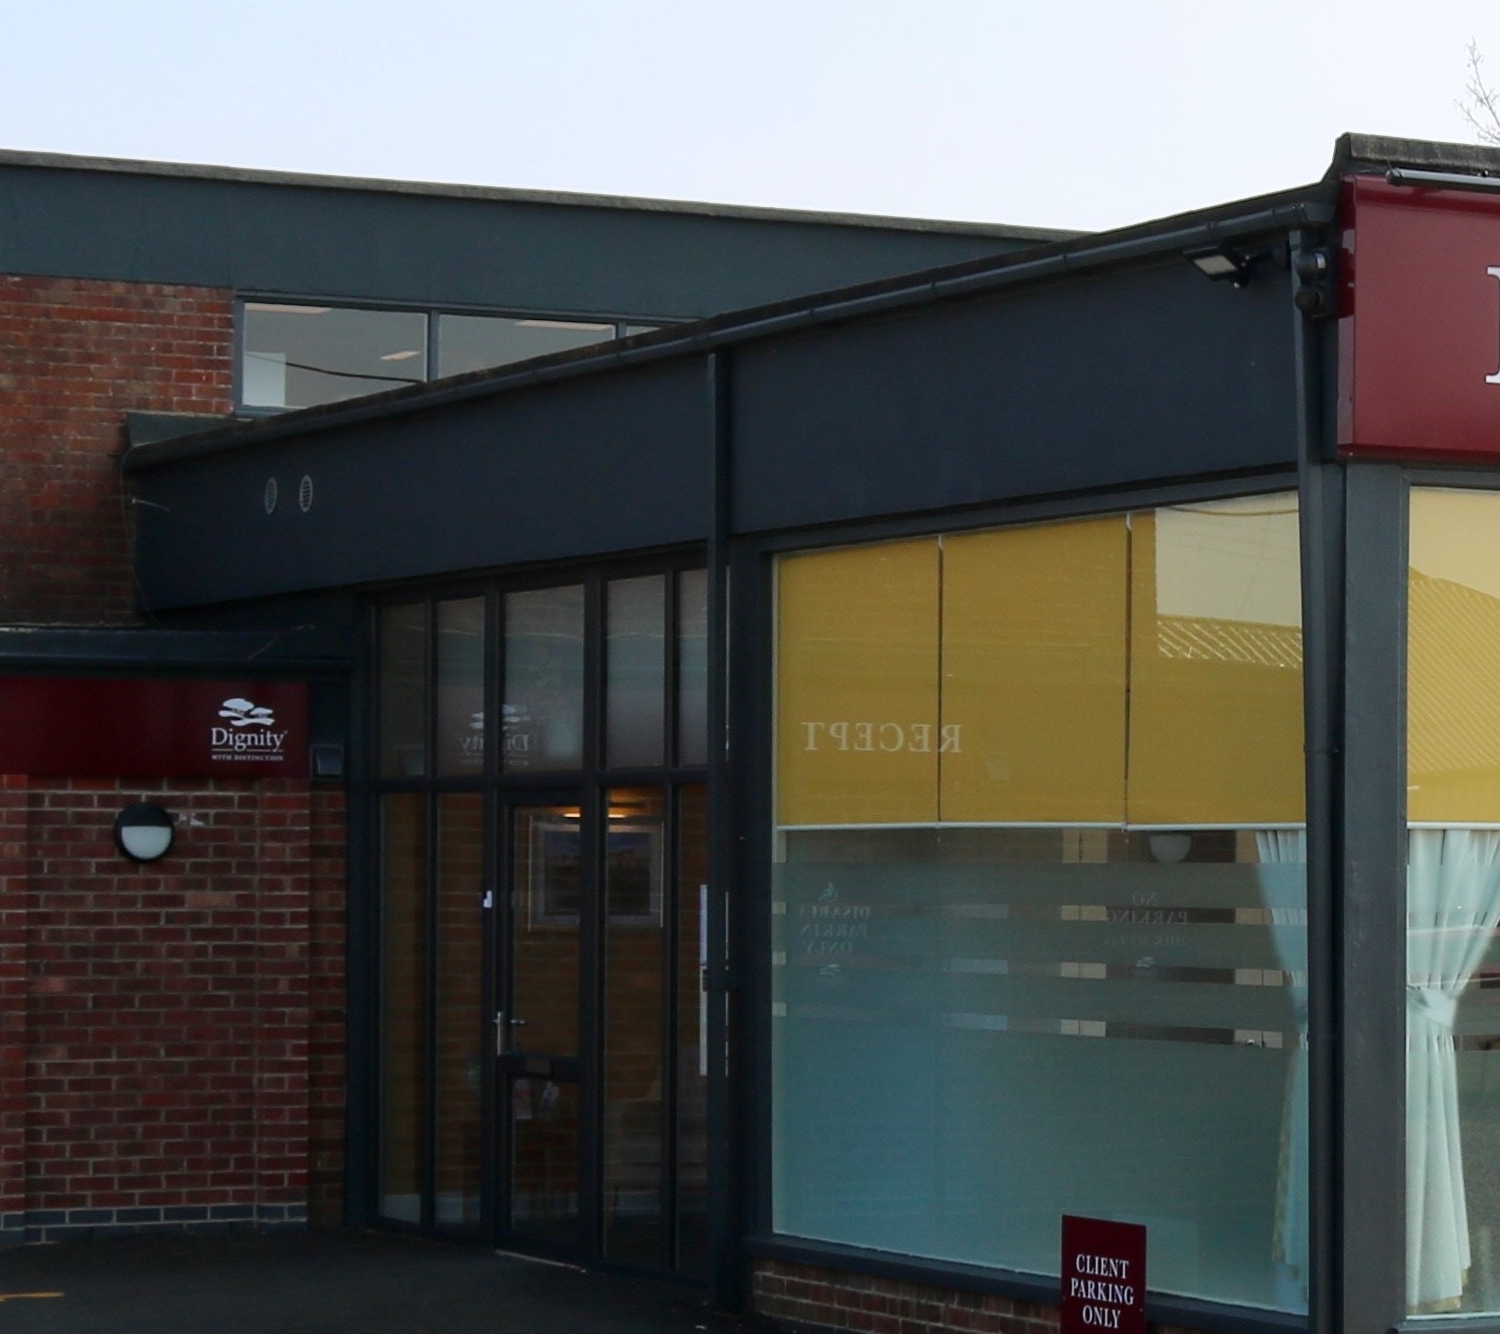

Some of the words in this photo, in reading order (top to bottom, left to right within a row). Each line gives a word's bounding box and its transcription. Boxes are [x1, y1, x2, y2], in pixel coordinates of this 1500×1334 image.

[211, 727, 284, 752] Dignity
[1075, 1253, 1129, 1279] CLIENT
[1070, 1277, 1134, 1306] PARKING
[1082, 1305, 1122, 1329] ONLY
